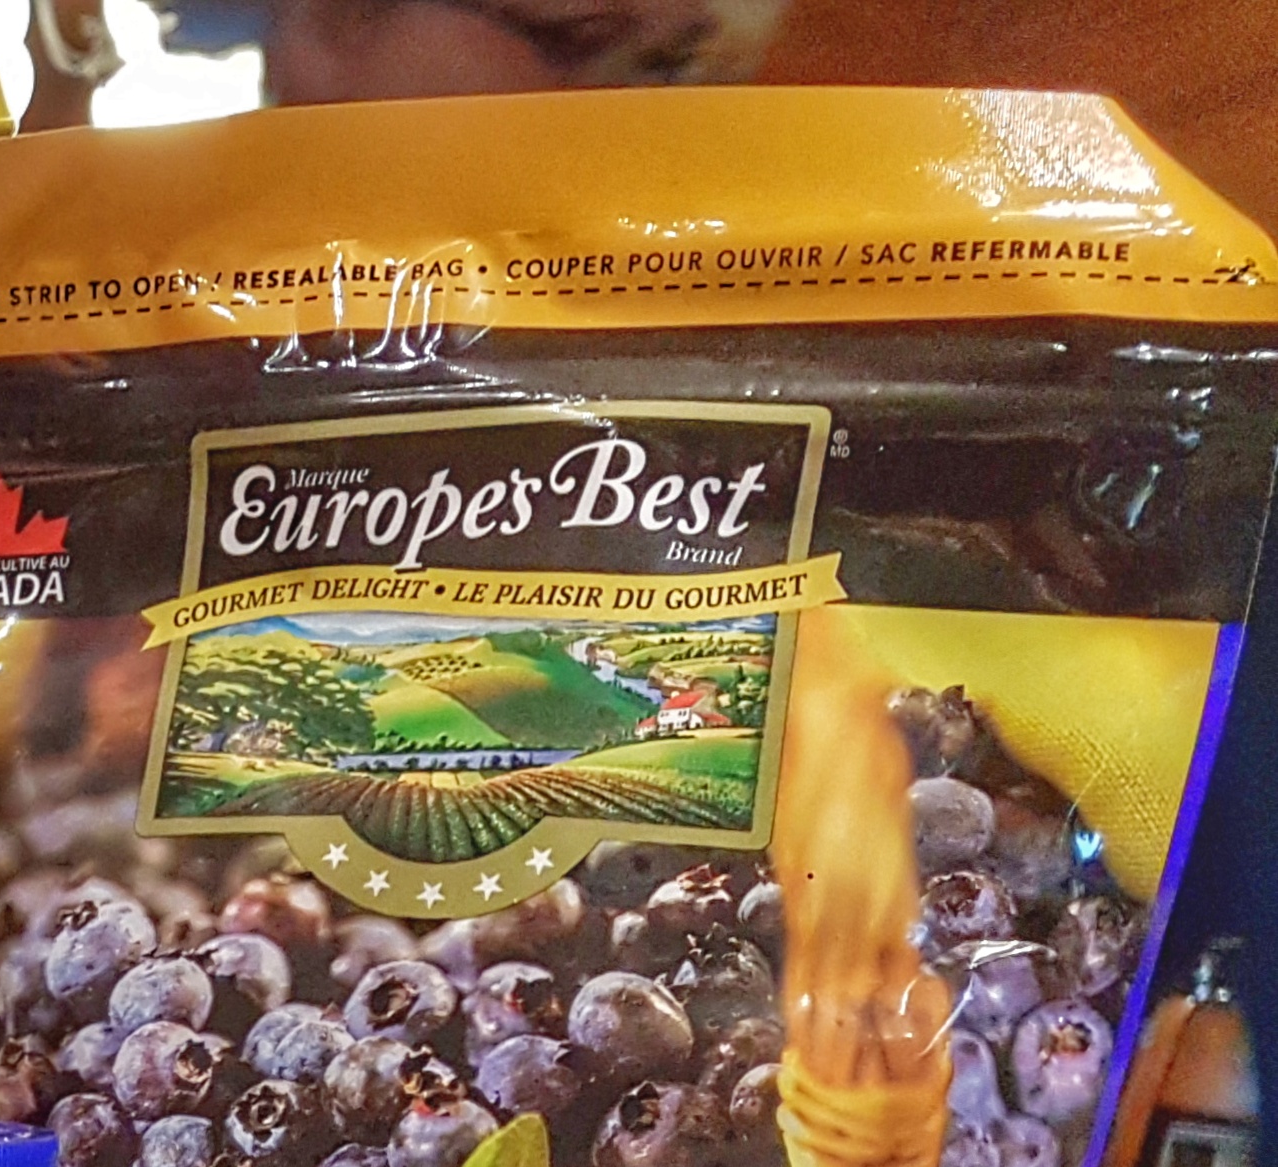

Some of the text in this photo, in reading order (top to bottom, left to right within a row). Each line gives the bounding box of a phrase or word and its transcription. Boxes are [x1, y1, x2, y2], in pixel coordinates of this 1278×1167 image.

[9, 283, 77, 305] STRIP
[87, 279, 121, 300] TO
[132, 272, 201, 297] OPEN
[233, 263, 399, 291] RESEALABLE
[411, 259, 465, 281] BAG
[506, 254, 616, 281] COUPER
[628, 250, 703, 274] POUR
[715, 246, 822, 271] OUVRIR
[859, 242, 917, 265] SAC
[930, 240, 1131, 264] REFERMABLE
[283, 464, 370, 491] Marque
[219, 436, 768, 573] Europe's Best
[49, 555, 71, 570] AU
[664, 538, 743, 568] Brand
[172, 572, 809, 630] GOURMET DELIGHT LE PLAISIR DU GOURMET
